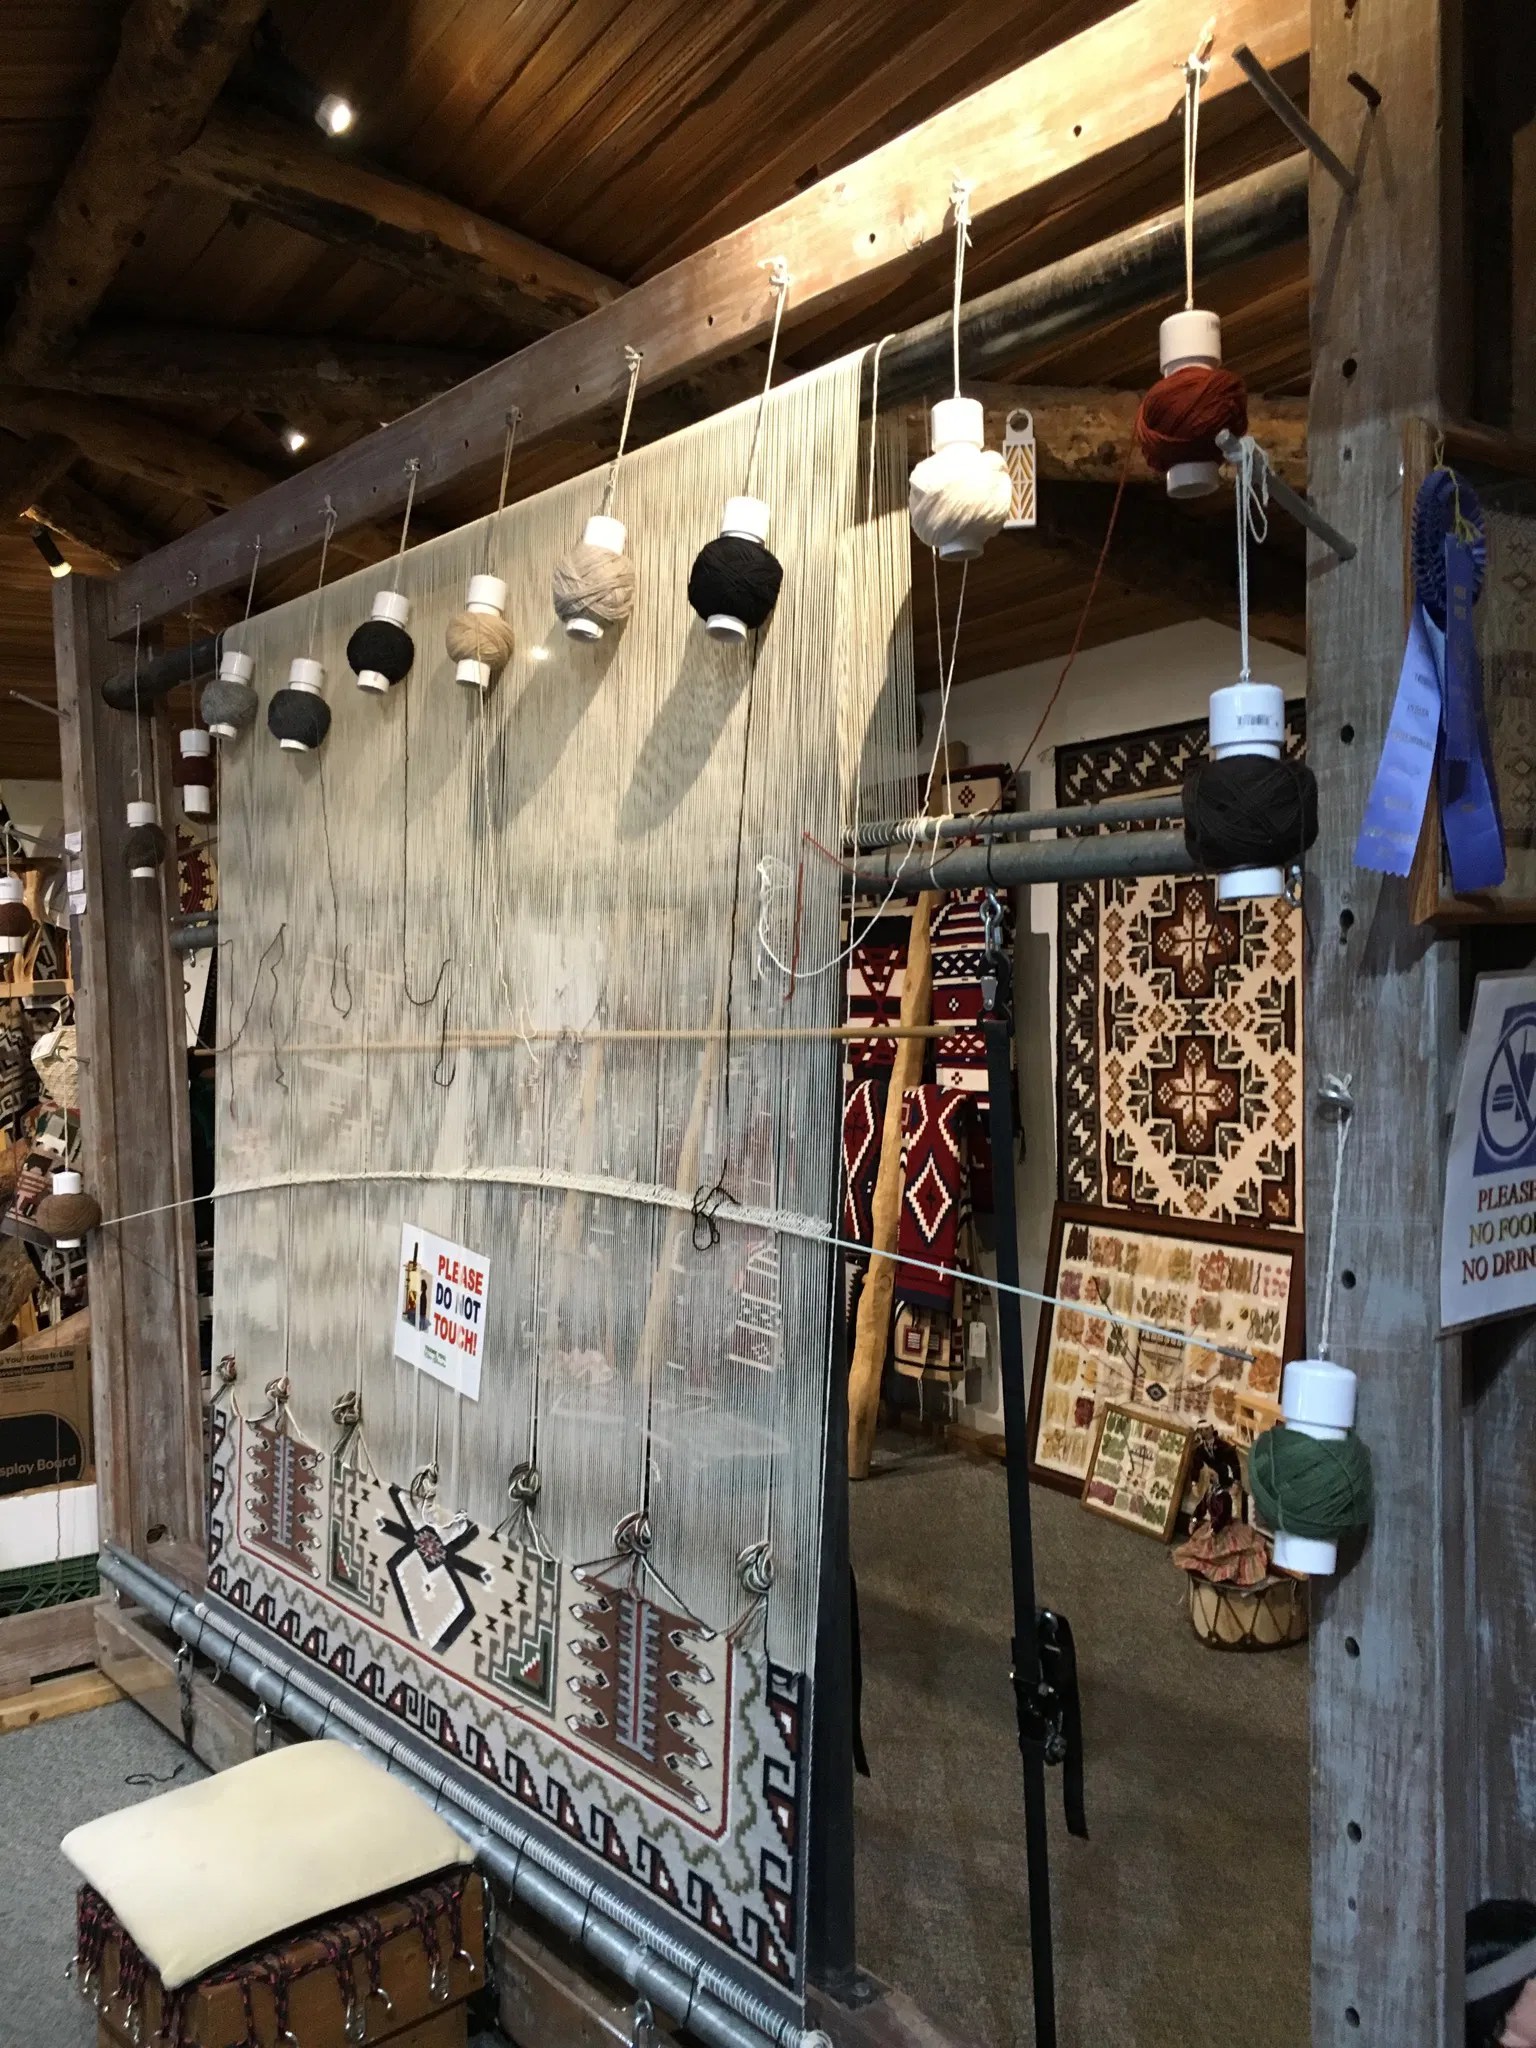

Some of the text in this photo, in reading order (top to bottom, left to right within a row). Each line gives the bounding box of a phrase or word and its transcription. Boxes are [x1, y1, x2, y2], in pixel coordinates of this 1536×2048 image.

[1469, 1211, 1536, 1249] NO FOO
[438, 1254, 484, 1296] PLEASE
[1462, 1255, 1488, 1285] NO
[436, 1282, 481, 1324] DO NOT
[434, 1312, 478, 1357] TOUCH!
[37, 1454, 77, 1471] Board
